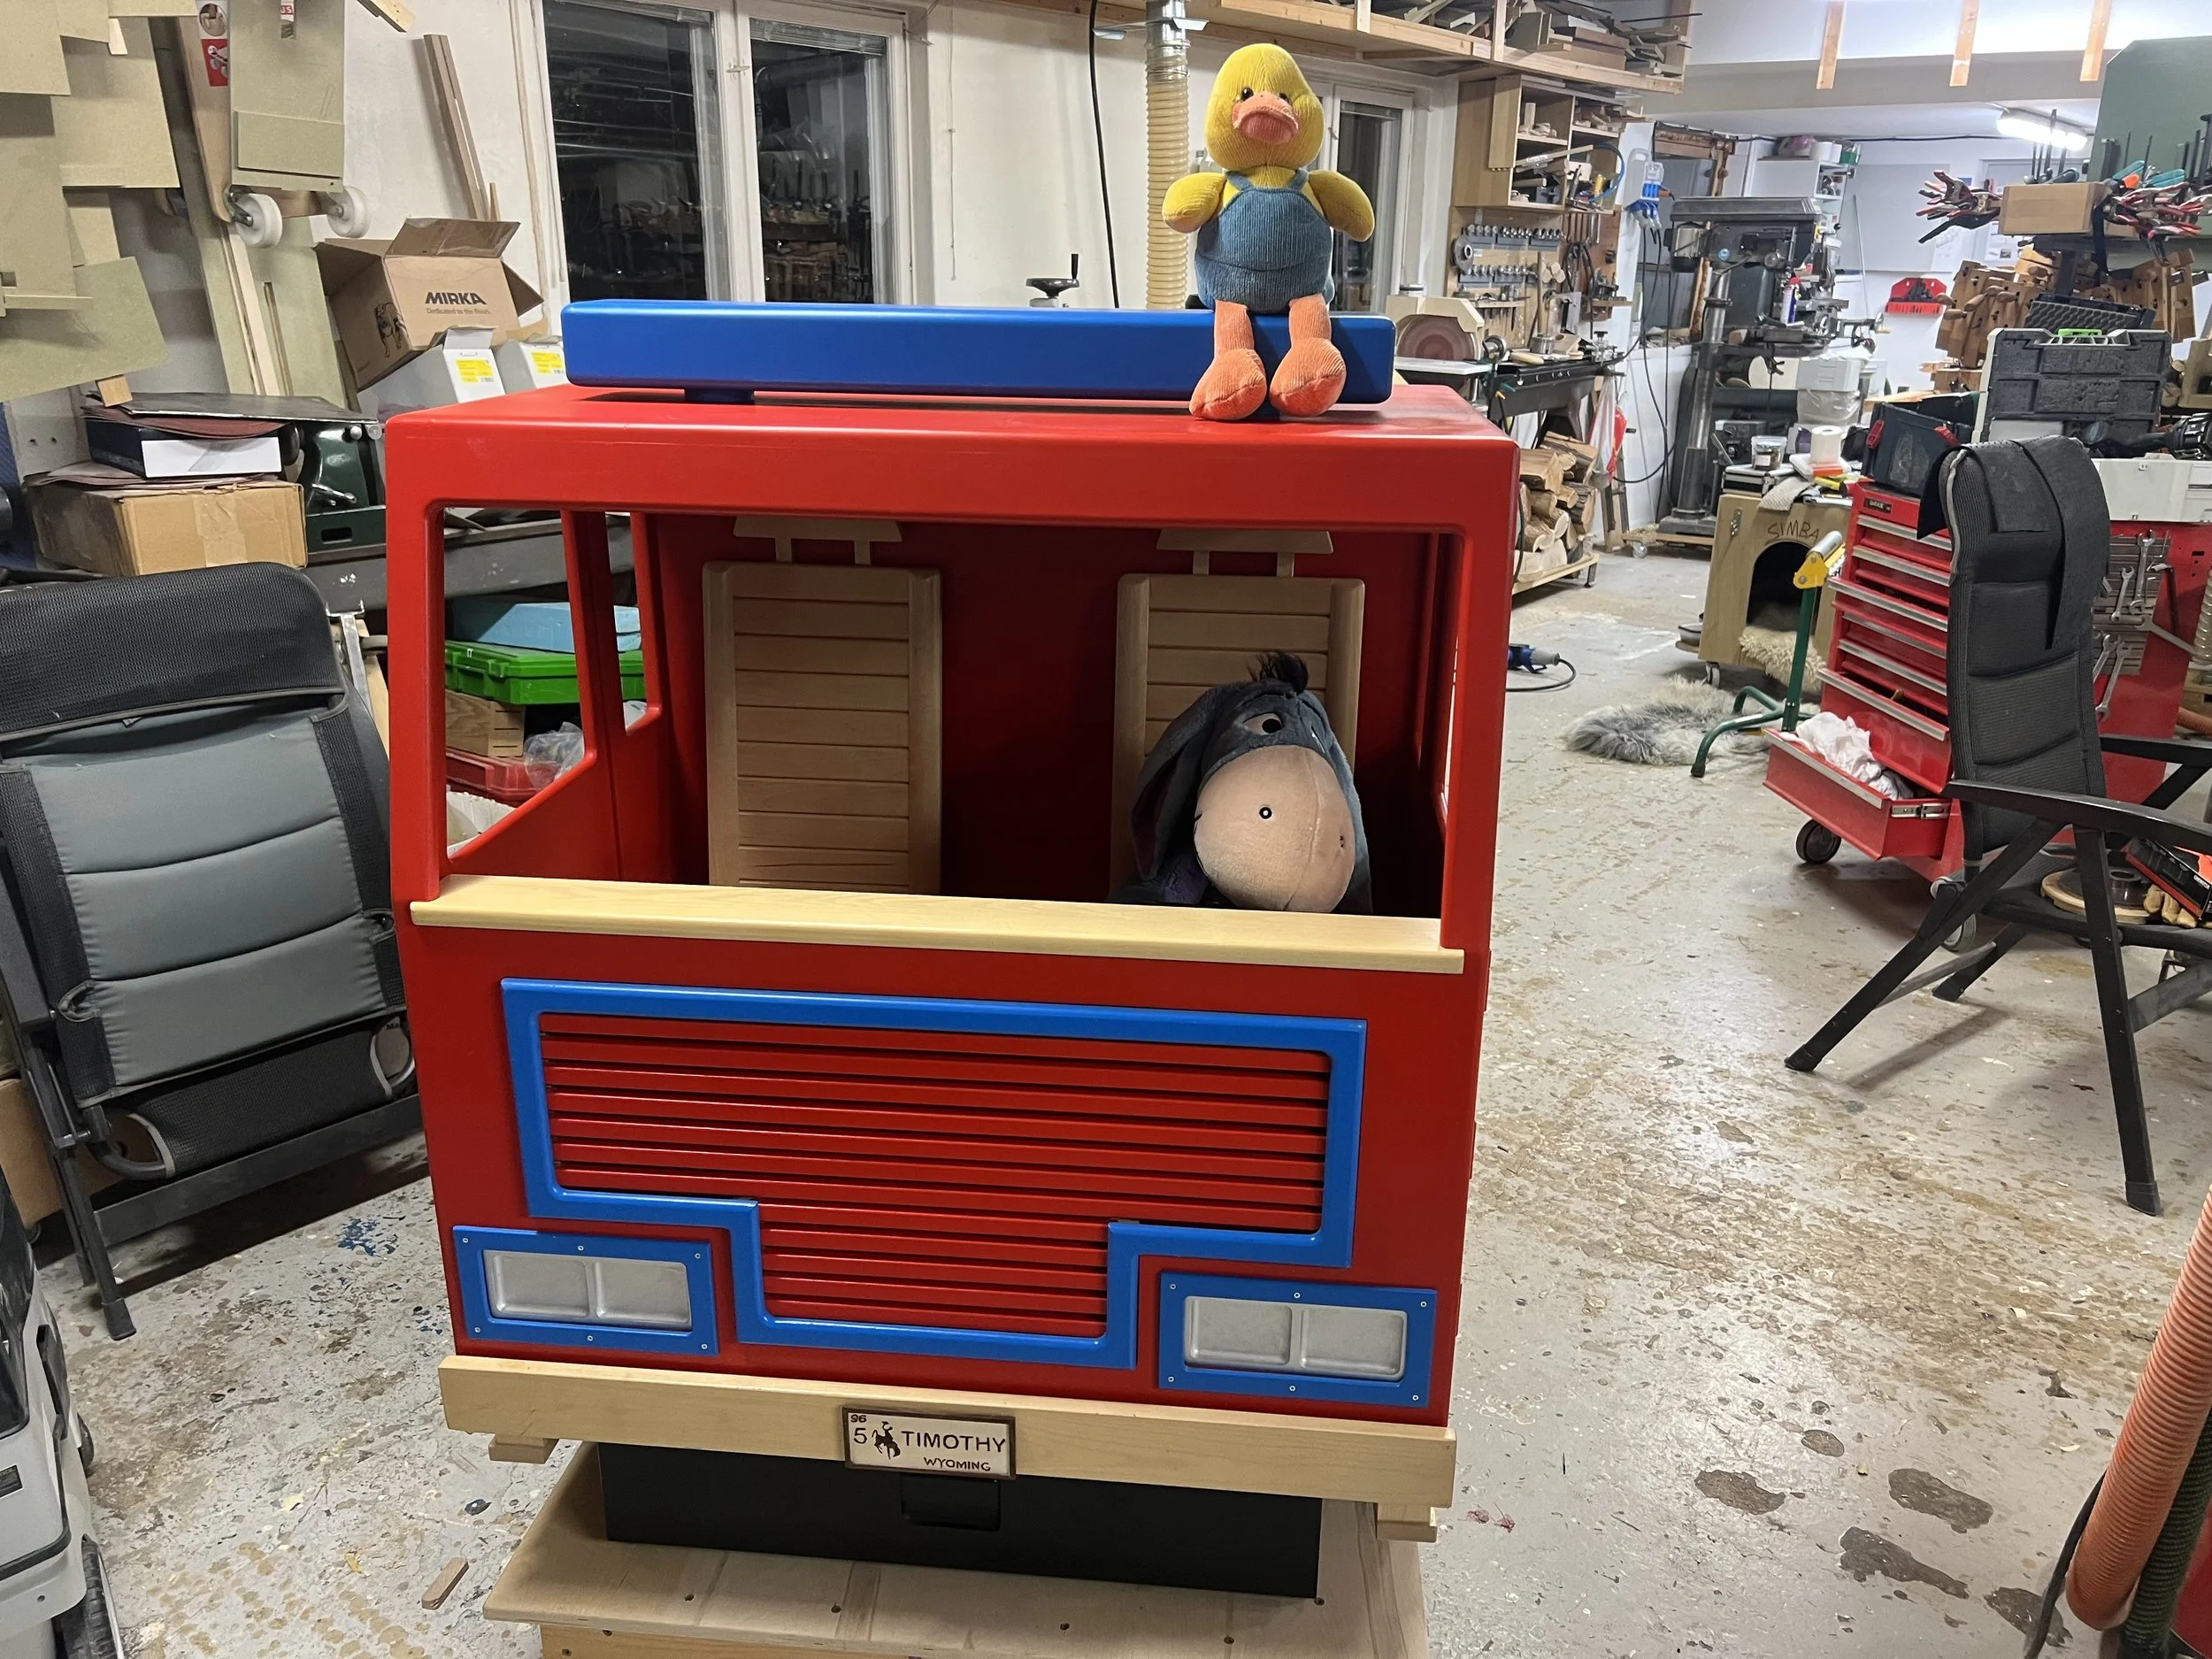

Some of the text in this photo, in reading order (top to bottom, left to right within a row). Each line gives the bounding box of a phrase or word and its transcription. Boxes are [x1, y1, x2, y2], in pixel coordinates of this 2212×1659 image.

[425, 291, 487, 304] MIRKA
[1767, 519, 1819, 547] SIMBA
[854, 1427, 1006, 1452] 5 TIMOTHY
[924, 1456, 991, 1471] WYOMING
